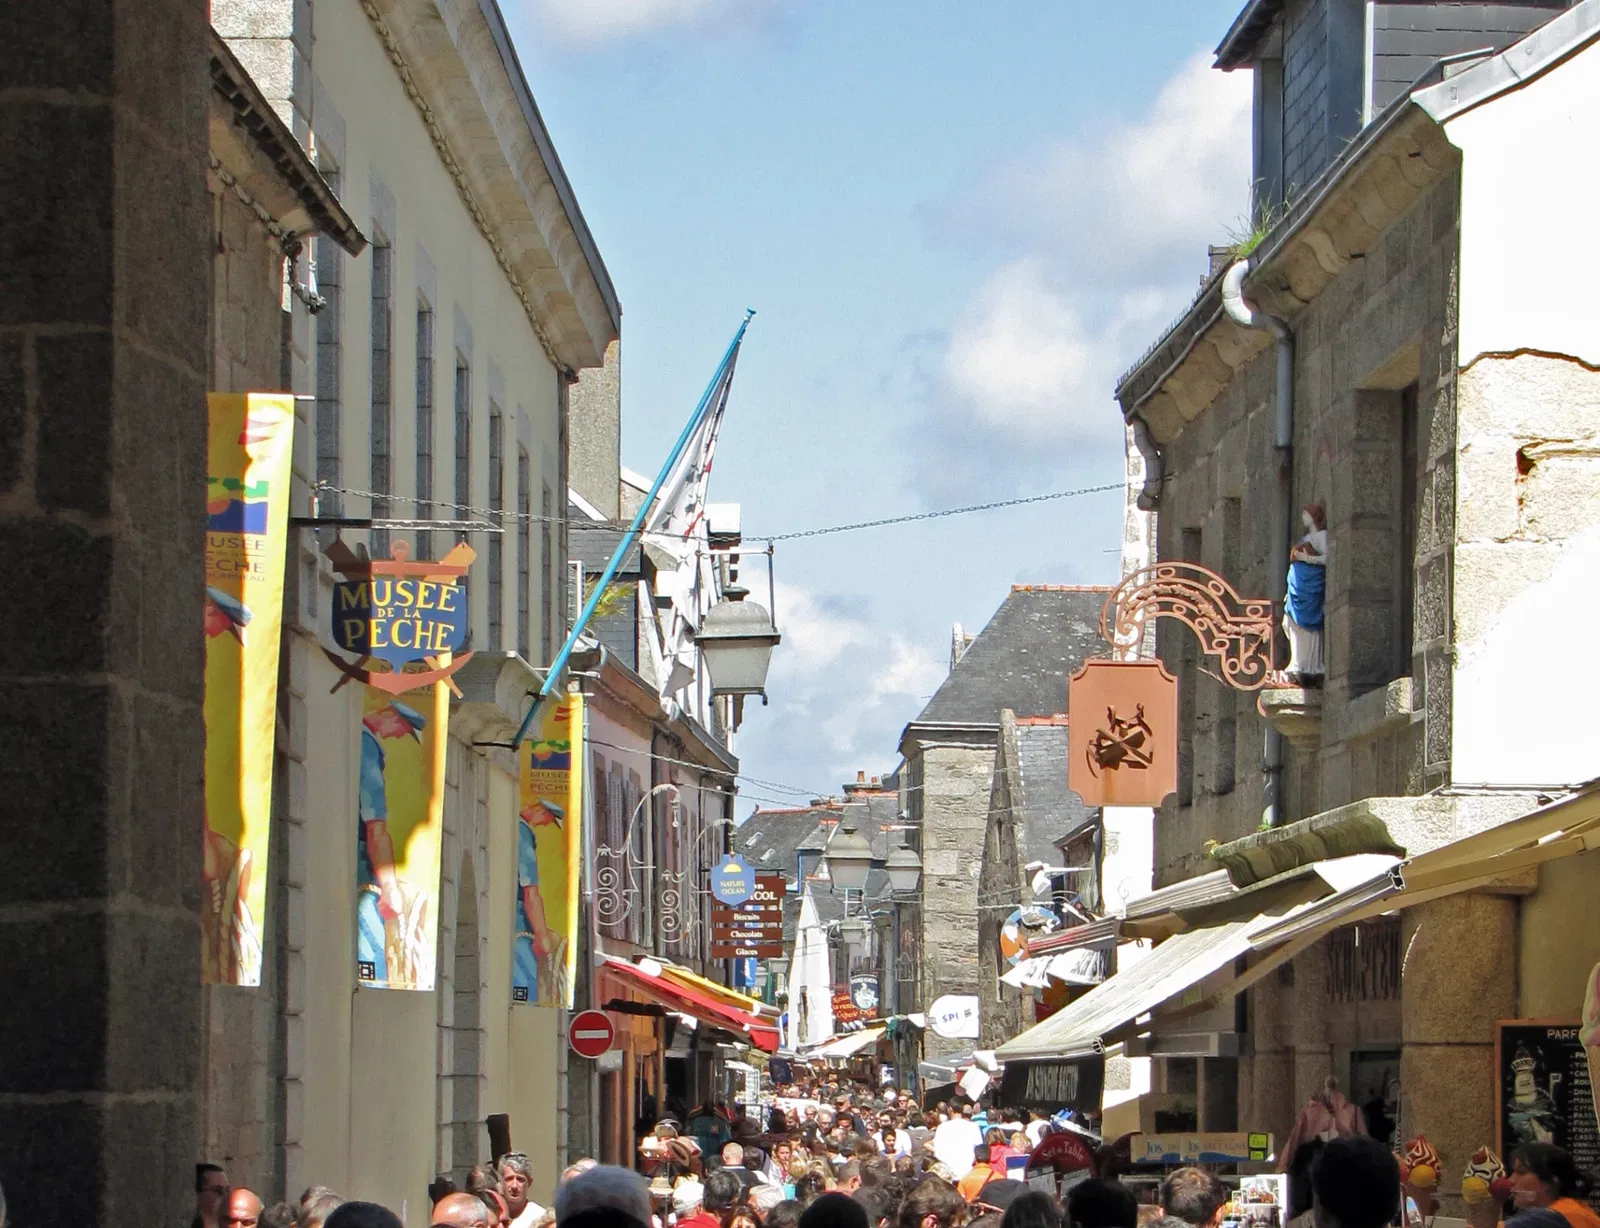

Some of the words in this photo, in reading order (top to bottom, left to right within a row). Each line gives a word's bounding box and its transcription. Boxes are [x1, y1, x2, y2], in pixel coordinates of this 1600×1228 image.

[207, 536, 266, 550] USÉE
[206, 557, 266, 573] ÊCHE
[340, 580, 459, 612] MUSEE
[377, 608, 394, 618] DE
[404, 608, 422, 619] LA
[733, 913, 761, 921] Biscuits
[730, 930, 764, 939] Chocolats
[735, 947, 759, 956] Glaces
[1041, 1148, 1056, 1161] Set
[1063, 1141, 1084, 1161] Table
